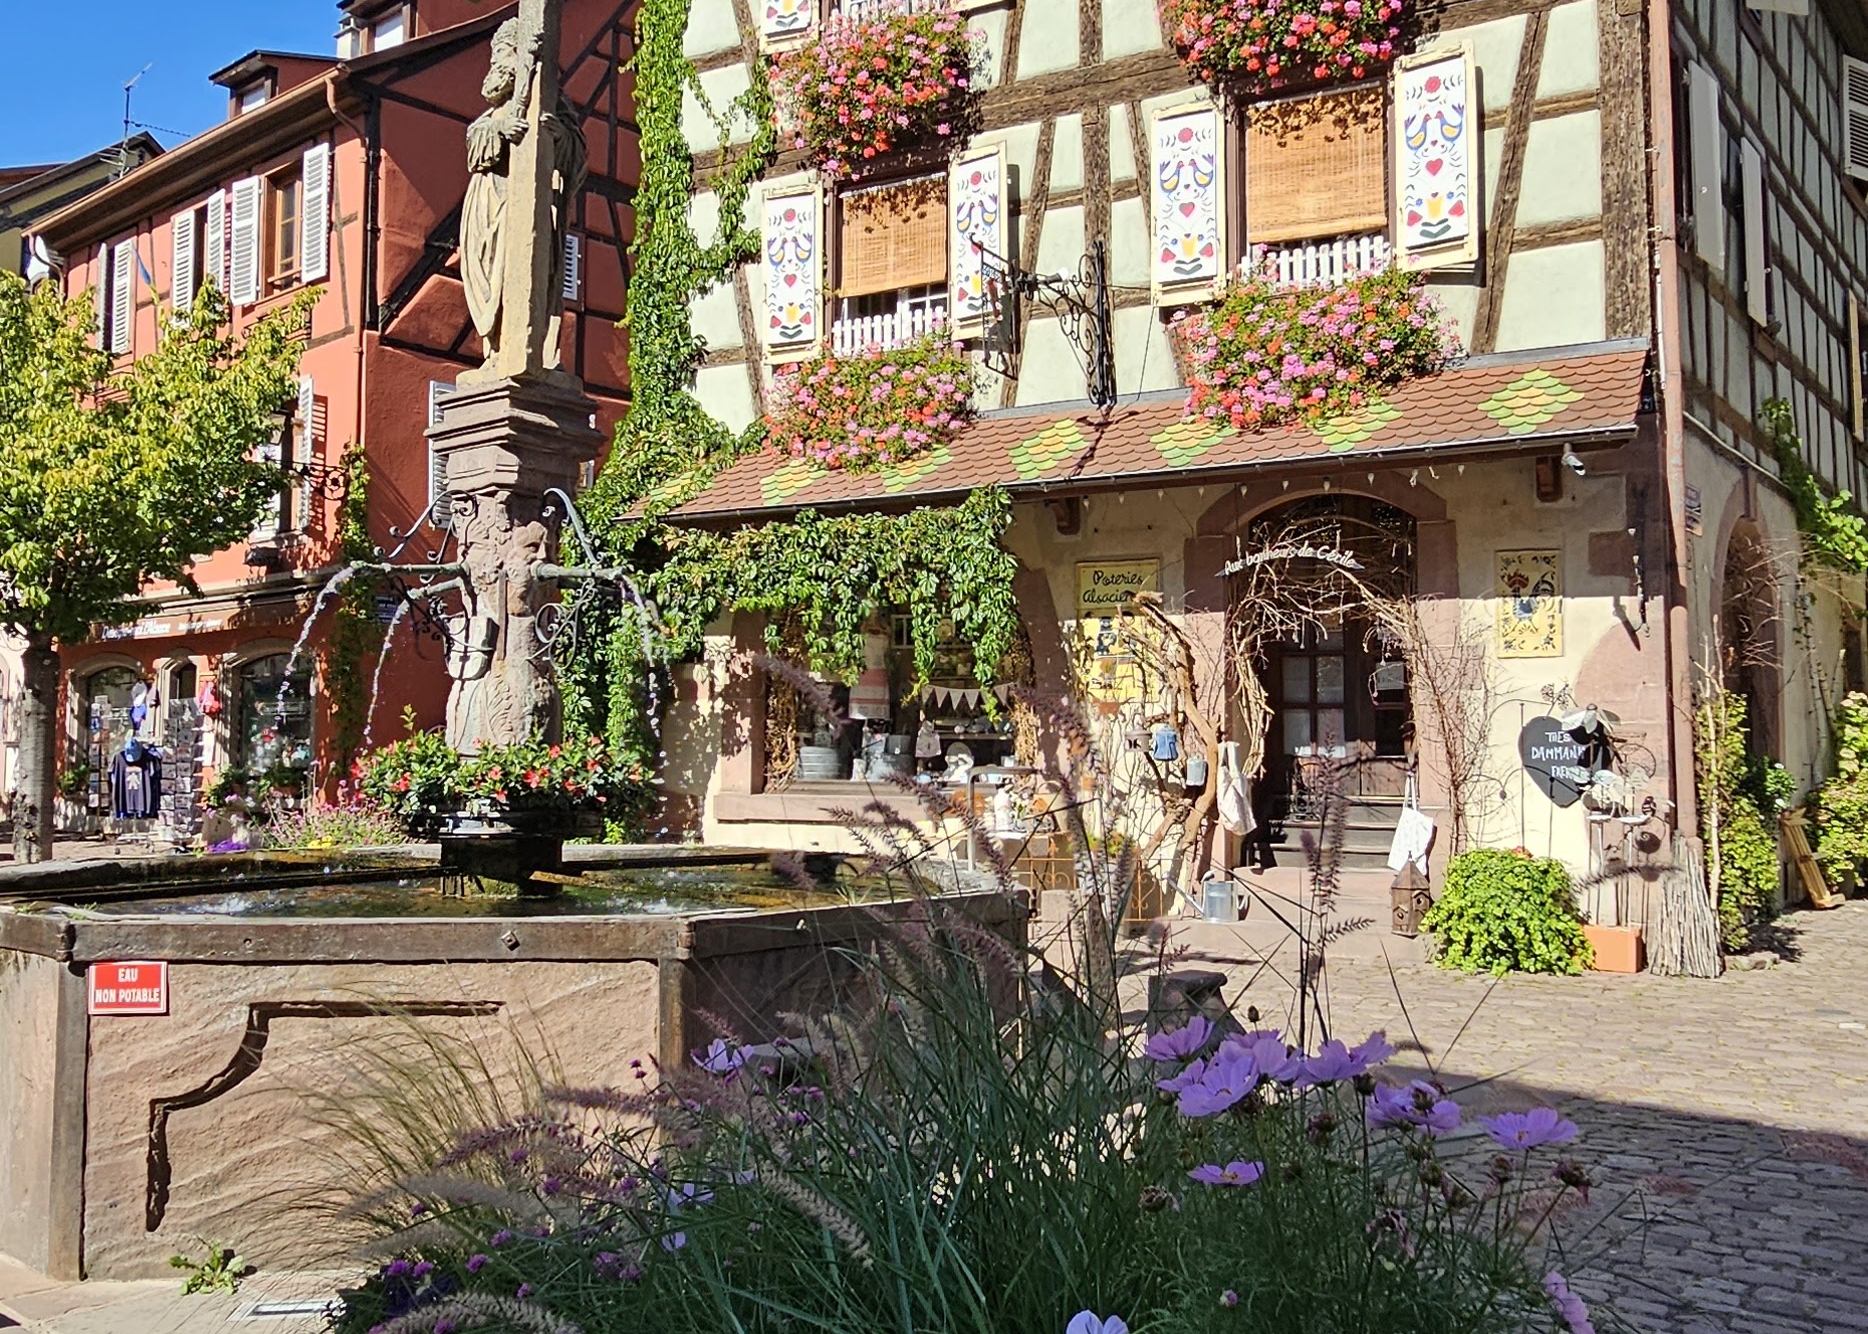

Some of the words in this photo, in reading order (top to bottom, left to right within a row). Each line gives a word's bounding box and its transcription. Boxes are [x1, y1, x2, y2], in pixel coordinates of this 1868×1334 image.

[1224, 559, 1243, 575] Aux
[1297, 540, 1314, 557] de
[1093, 570, 1144, 586] Poteries
[118, 968, 138, 982] EAU
[95, 989, 116, 1003] NON
[118, 987, 160, 1003] POTABLE
